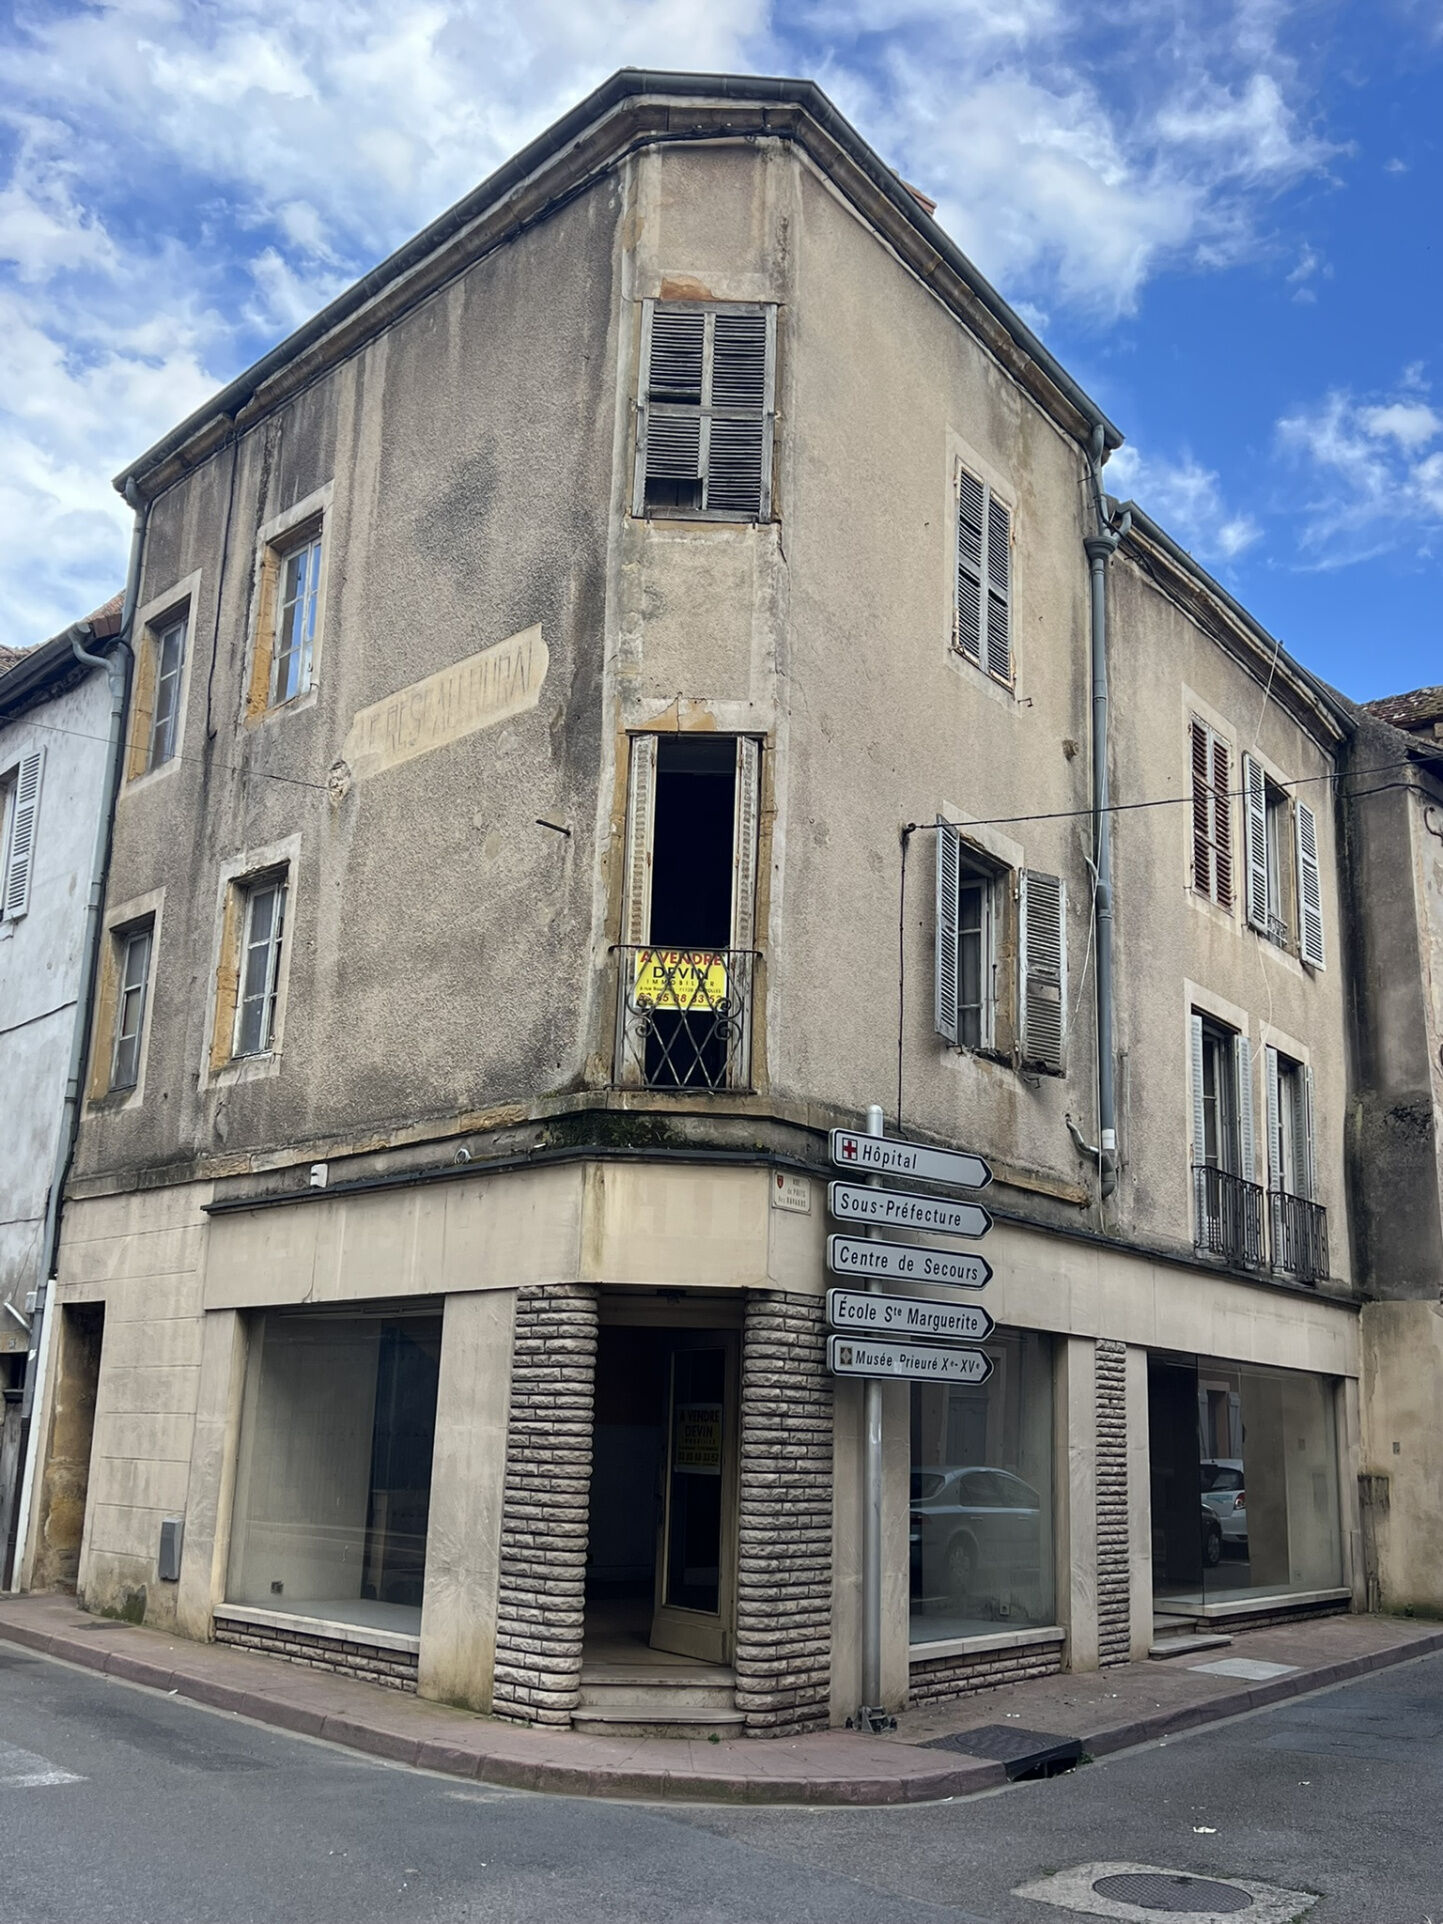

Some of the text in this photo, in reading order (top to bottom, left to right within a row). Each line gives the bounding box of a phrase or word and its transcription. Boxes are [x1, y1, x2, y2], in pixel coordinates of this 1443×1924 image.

[640, 951, 722, 966] A VENDRE
[653, 966, 709, 980] DEVIN
[862, 1144, 917, 1170] Hôpital
[841, 1193, 961, 1226] Sous-Préfecture
[840, 1246, 978, 1281] Centre de Secours
[838, 1296, 877, 1321] École
[907, 1308, 978, 1331] Marguerite
[856, 1350, 893, 1367] Musée
[900, 1354, 938, 1371] Prieuré
